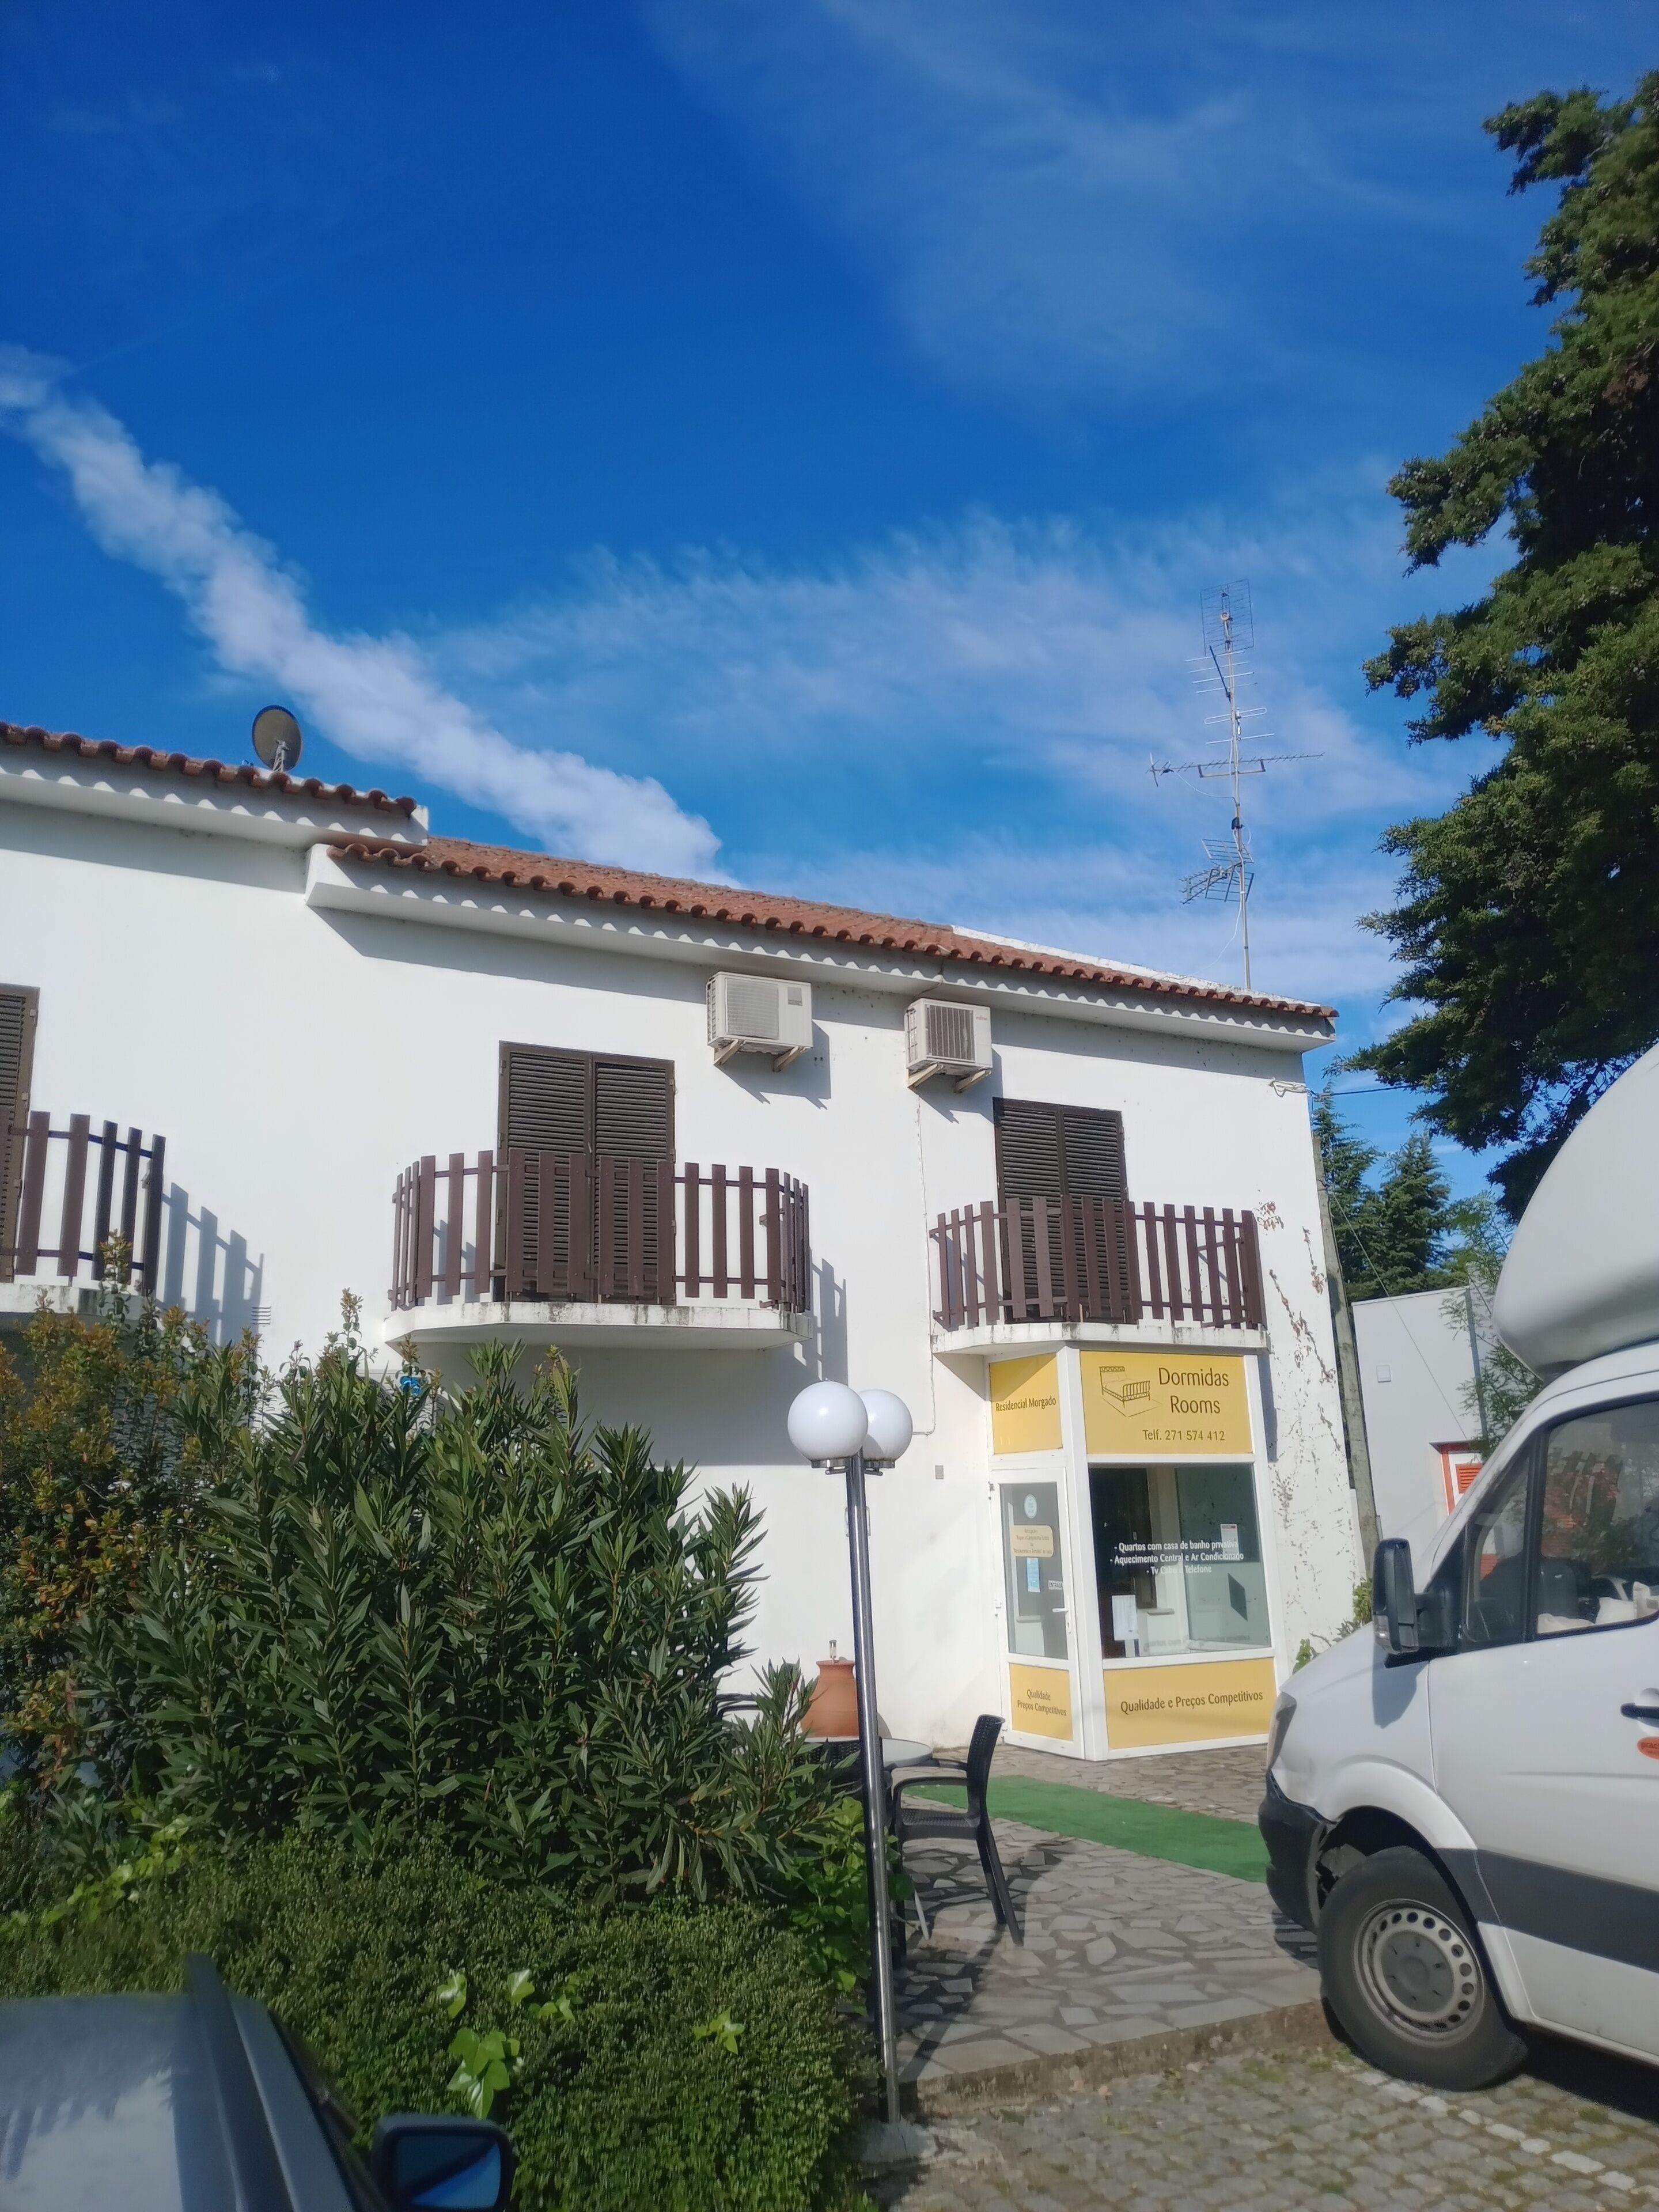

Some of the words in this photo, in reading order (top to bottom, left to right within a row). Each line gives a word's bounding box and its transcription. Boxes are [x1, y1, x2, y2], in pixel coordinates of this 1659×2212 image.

[1158, 1367, 1229, 1387] Dormidas
[995, 1397, 1028, 1412] Residencial
[1029, 1395, 1056, 1410] Morgado
[1171, 1395, 1221, 1414] Rooms
[1142, 1429, 1162, 1441] Telf.
[1165, 1430, 1182, 1441] 271
[1186, 1430, 1203, 1441] 574
[1207, 1430, 1225, 1441] 412
[1119, 1543, 1146, 1554] Quartos
[1180, 1540, 1188, 1550] de
[1190, 1540, 1210, 1550] banho
[1211, 1540, 1238, 1551] privativa
[1114, 1554, 1158, 1567] Aquecimento
[1160, 1552, 1183, 1562] Central
[1191, 1553, 1199, 1562] Ar
[1200, 1552, 1244, 1561] Condicionado
[1150, 1566, 1158, 1575] Tv
[1184, 1565, 1212, 1574] Telefone
[1027, 1689, 1051, 1701] Qualidade
[1121, 1697, 1165, 1715] Qualidade
[1168, 1699, 1173, 1708] e
[1176, 1696, 1206, 1709] Preços
[1208, 1690, 1263, 1706] Competitivos
[1017, 1699, 1034, 1712] Preços
[1034, 1703, 1067, 1716] Competitivos
[1641, 1741, 1659, 1750] prac
